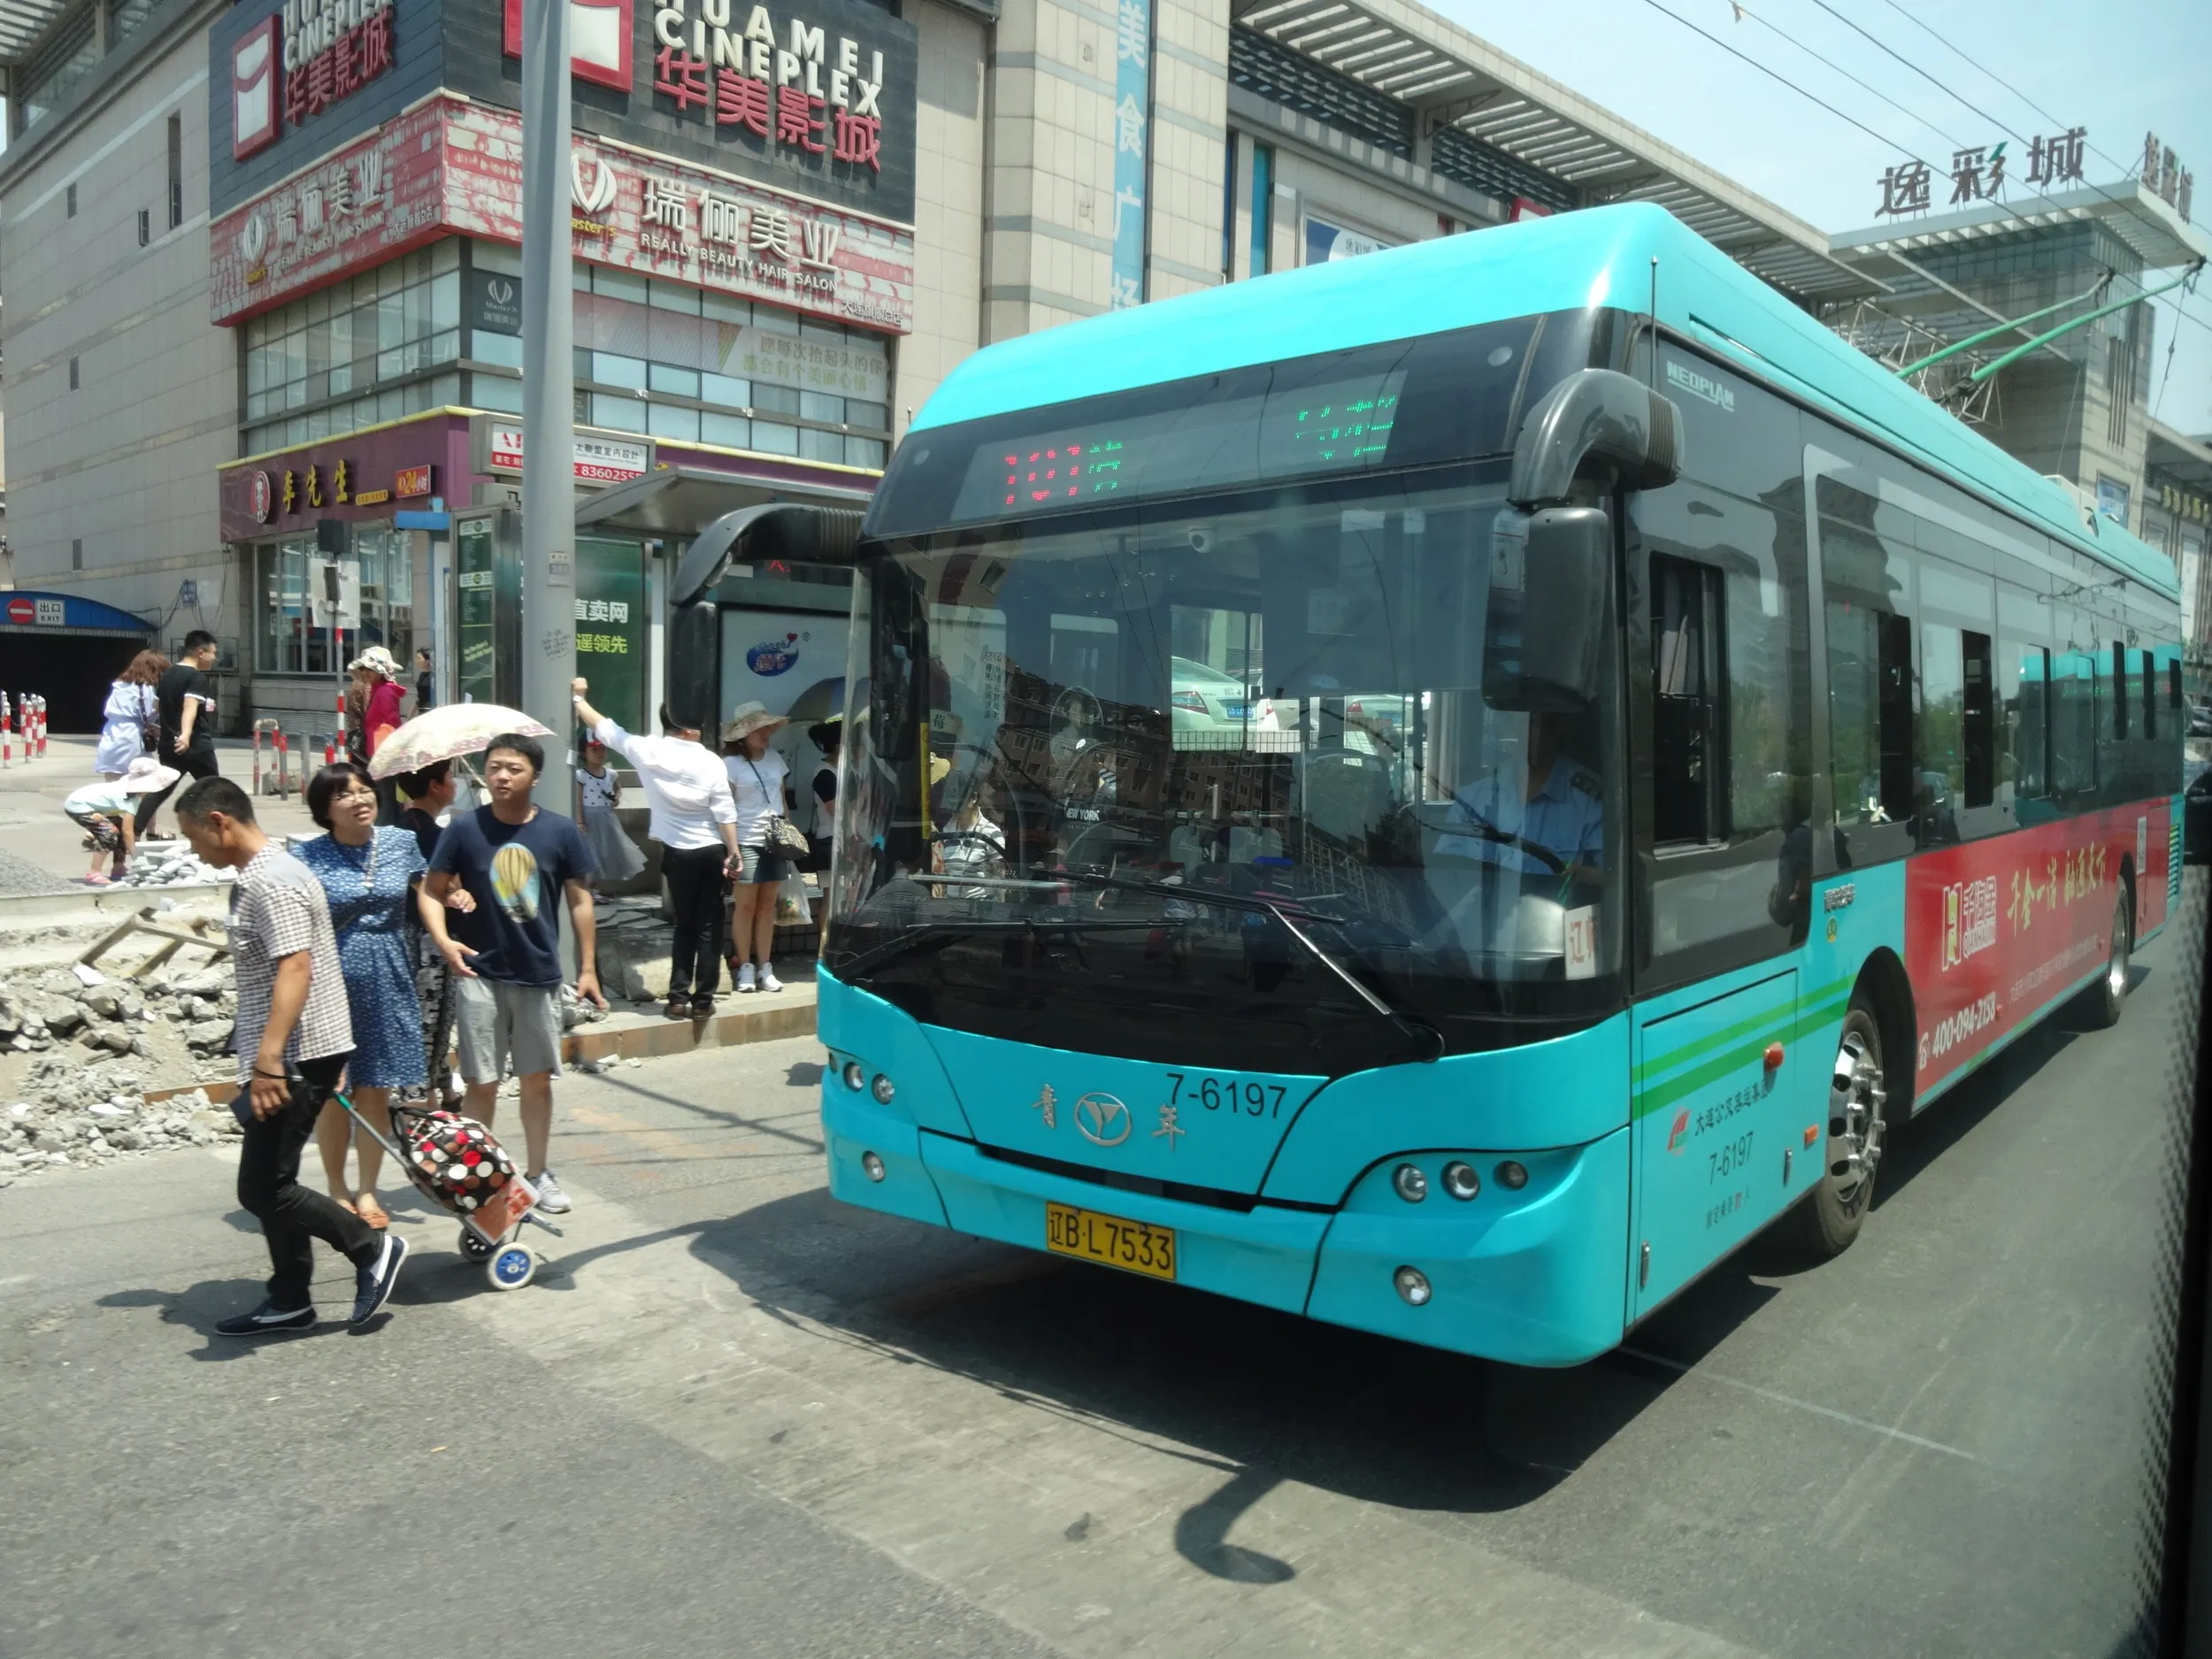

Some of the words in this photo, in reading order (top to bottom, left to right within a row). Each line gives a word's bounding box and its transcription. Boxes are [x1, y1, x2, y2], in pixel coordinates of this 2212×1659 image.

[283, 9, 391, 123] 华美影城
[655, 9, 881, 119] CINEPLEX
[654, 47, 881, 173] 华美影城
[1874, 126, 2089, 219] 逸彩城
[643, 178, 840, 272] 瑞俪美业
[641, 232, 694, 257] REALLY
[700, 247, 754, 271] BEAUTY
[758, 263, 790, 280] HAIR
[795, 271, 838, 292] SALON
[1666, 359, 1734, 407] NEOPLAN
[282, 458, 349, 514] 李先生
[40, 602, 61, 613] 出口
[1079, 809, 1100, 822] YORK
[1166, 1072, 1287, 1119] 7-6197
[1709, 1130, 1755, 1187] 7-6197
